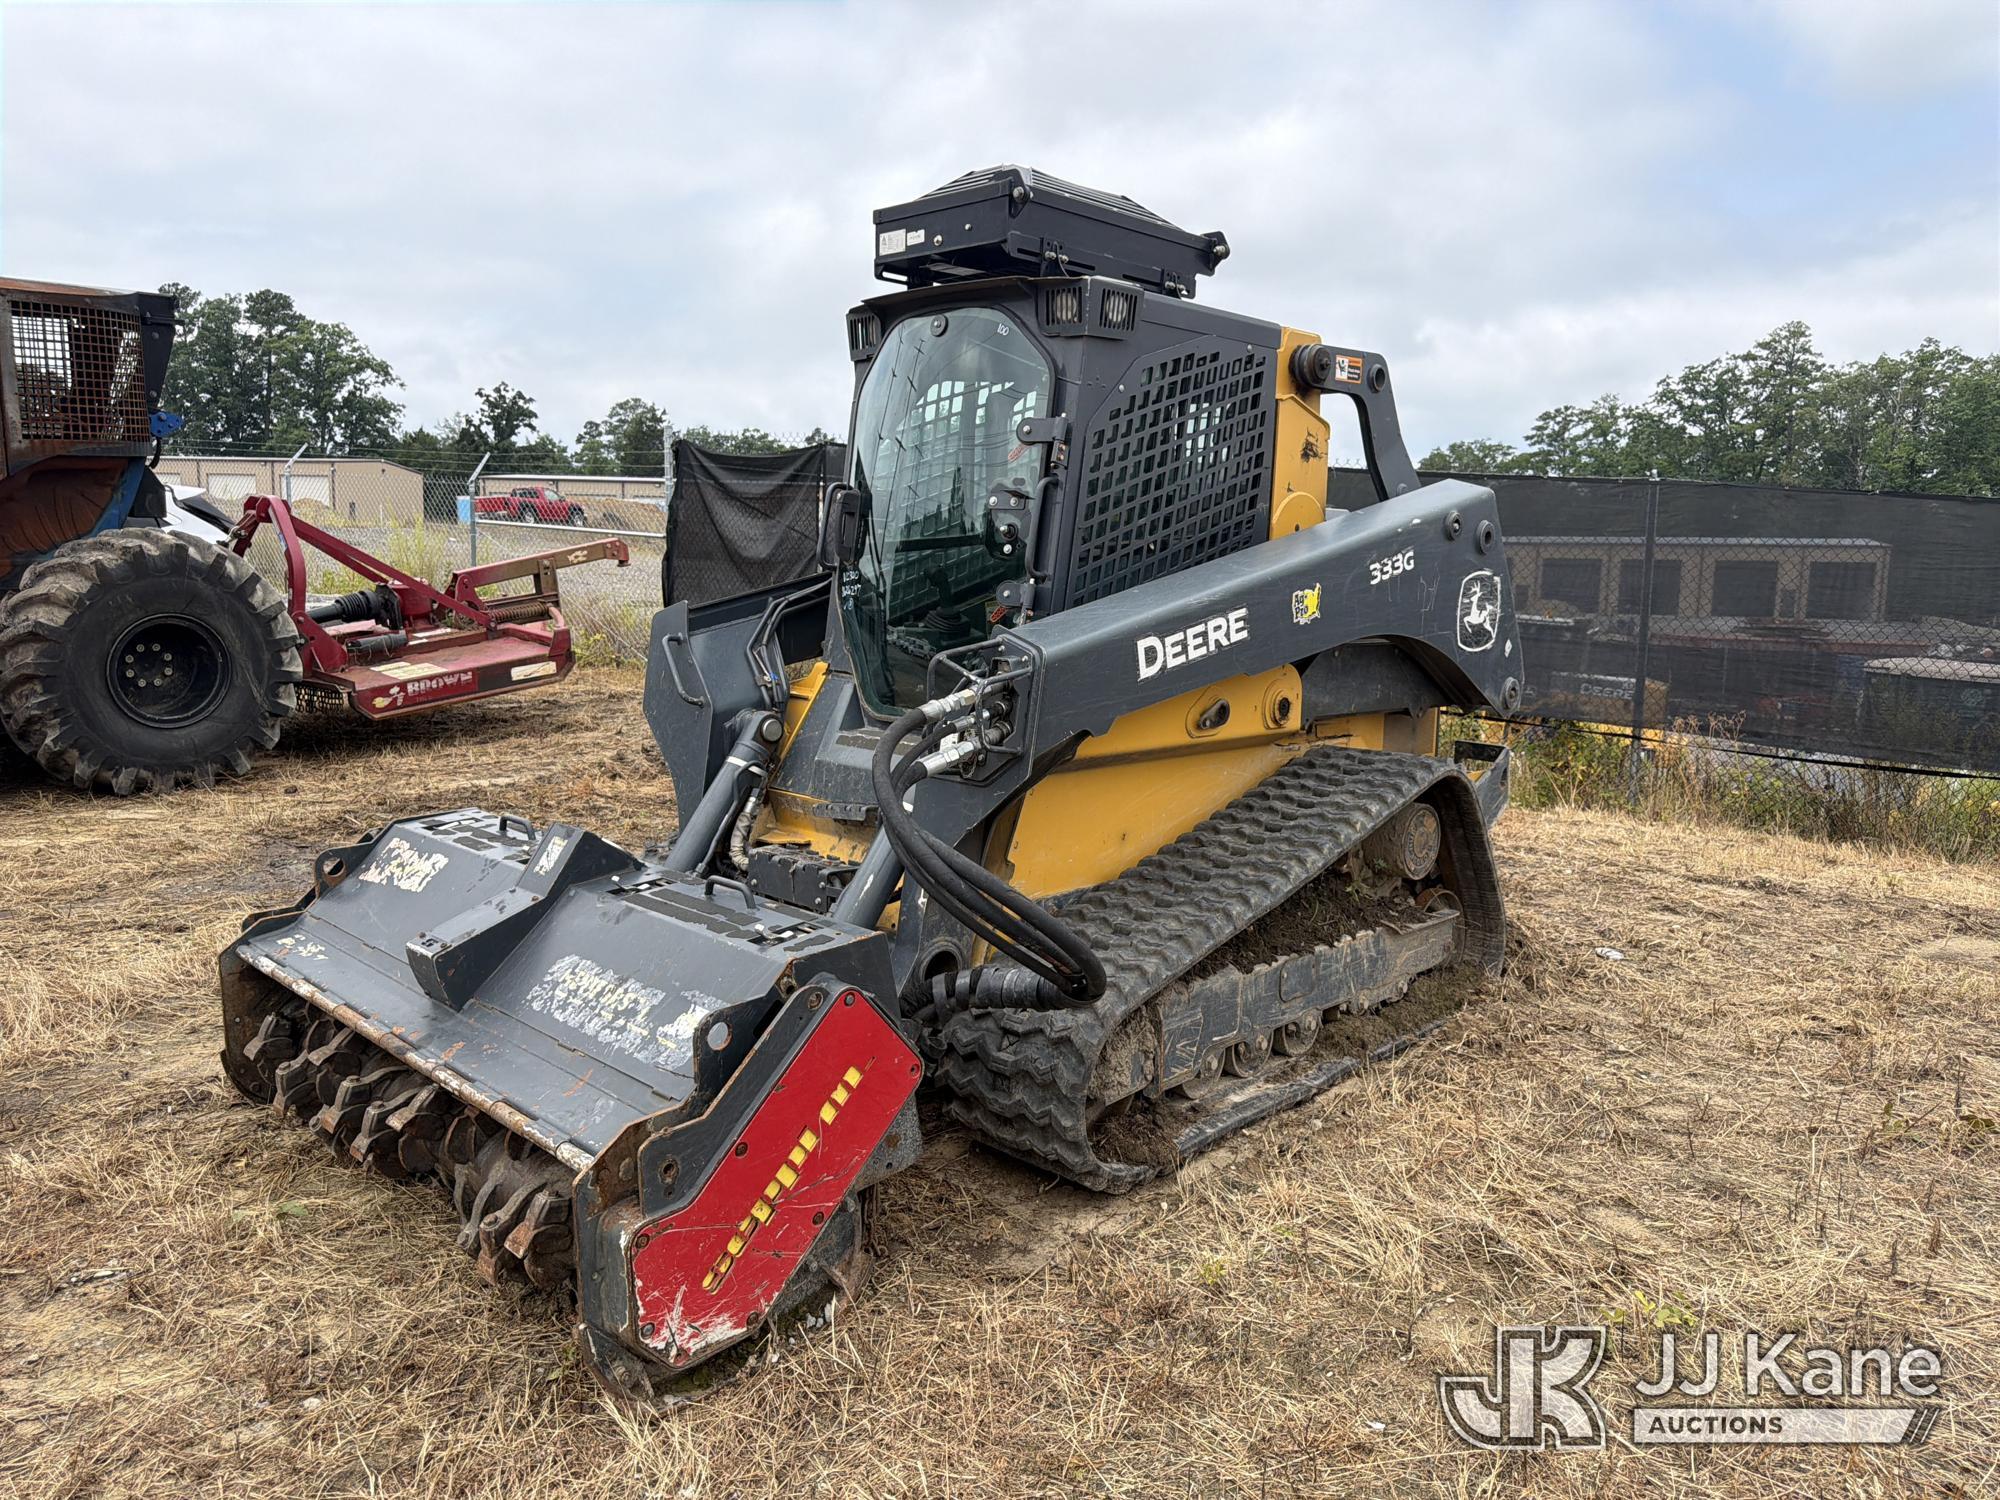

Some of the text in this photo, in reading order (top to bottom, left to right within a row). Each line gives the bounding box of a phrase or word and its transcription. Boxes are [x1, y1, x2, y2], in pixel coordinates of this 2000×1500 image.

[1369, 549, 1415, 585] 333G
[1136, 607, 1249, 682] DEERE
[406, 671, 473, 697] BROWN
